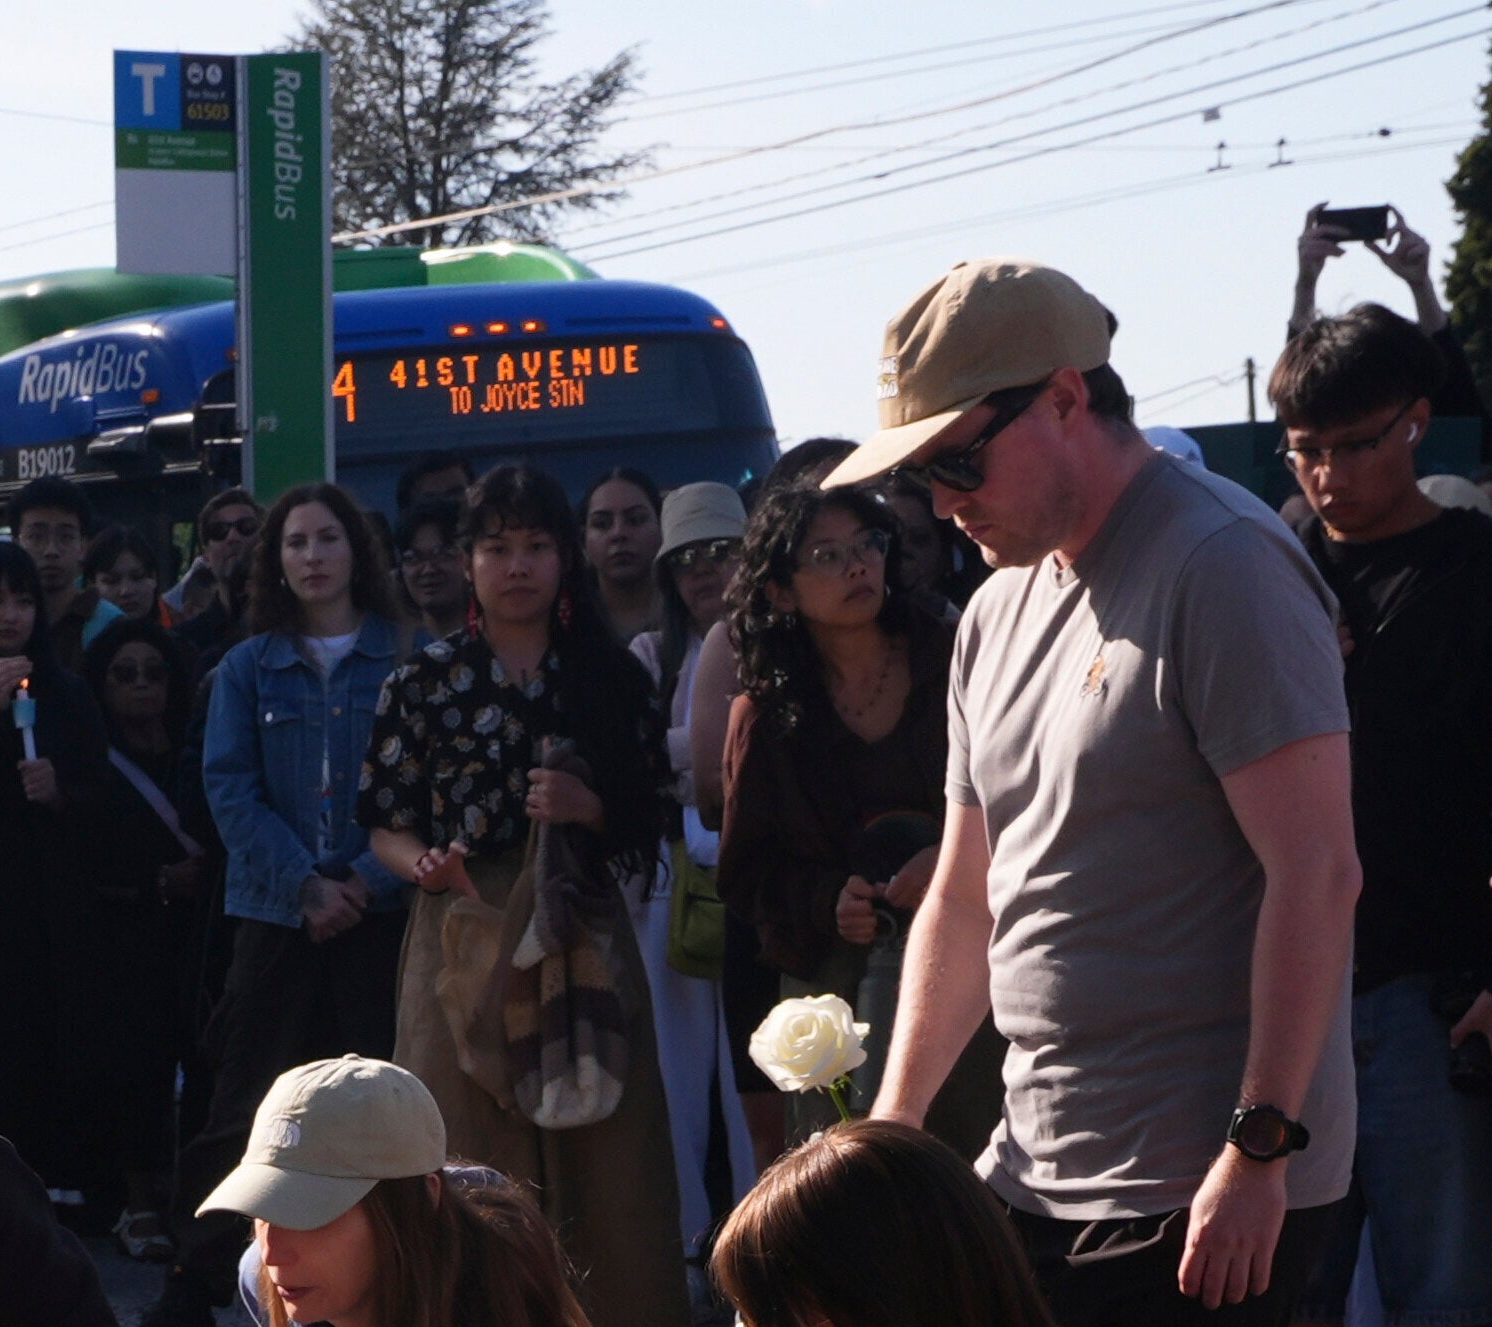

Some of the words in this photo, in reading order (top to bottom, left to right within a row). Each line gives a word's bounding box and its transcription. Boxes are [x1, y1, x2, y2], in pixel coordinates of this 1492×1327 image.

[266, 67, 303, 220] RapidBus
[18, 343, 149, 413] RapidBus
[389, 354, 479, 389] 41ST
[496, 344, 640, 382] AVENUE
[449, 385, 472, 414] TO
[480, 380, 541, 413] JOYCE
[549, 378, 585, 408] STN
[17, 446, 77, 479] B19012
